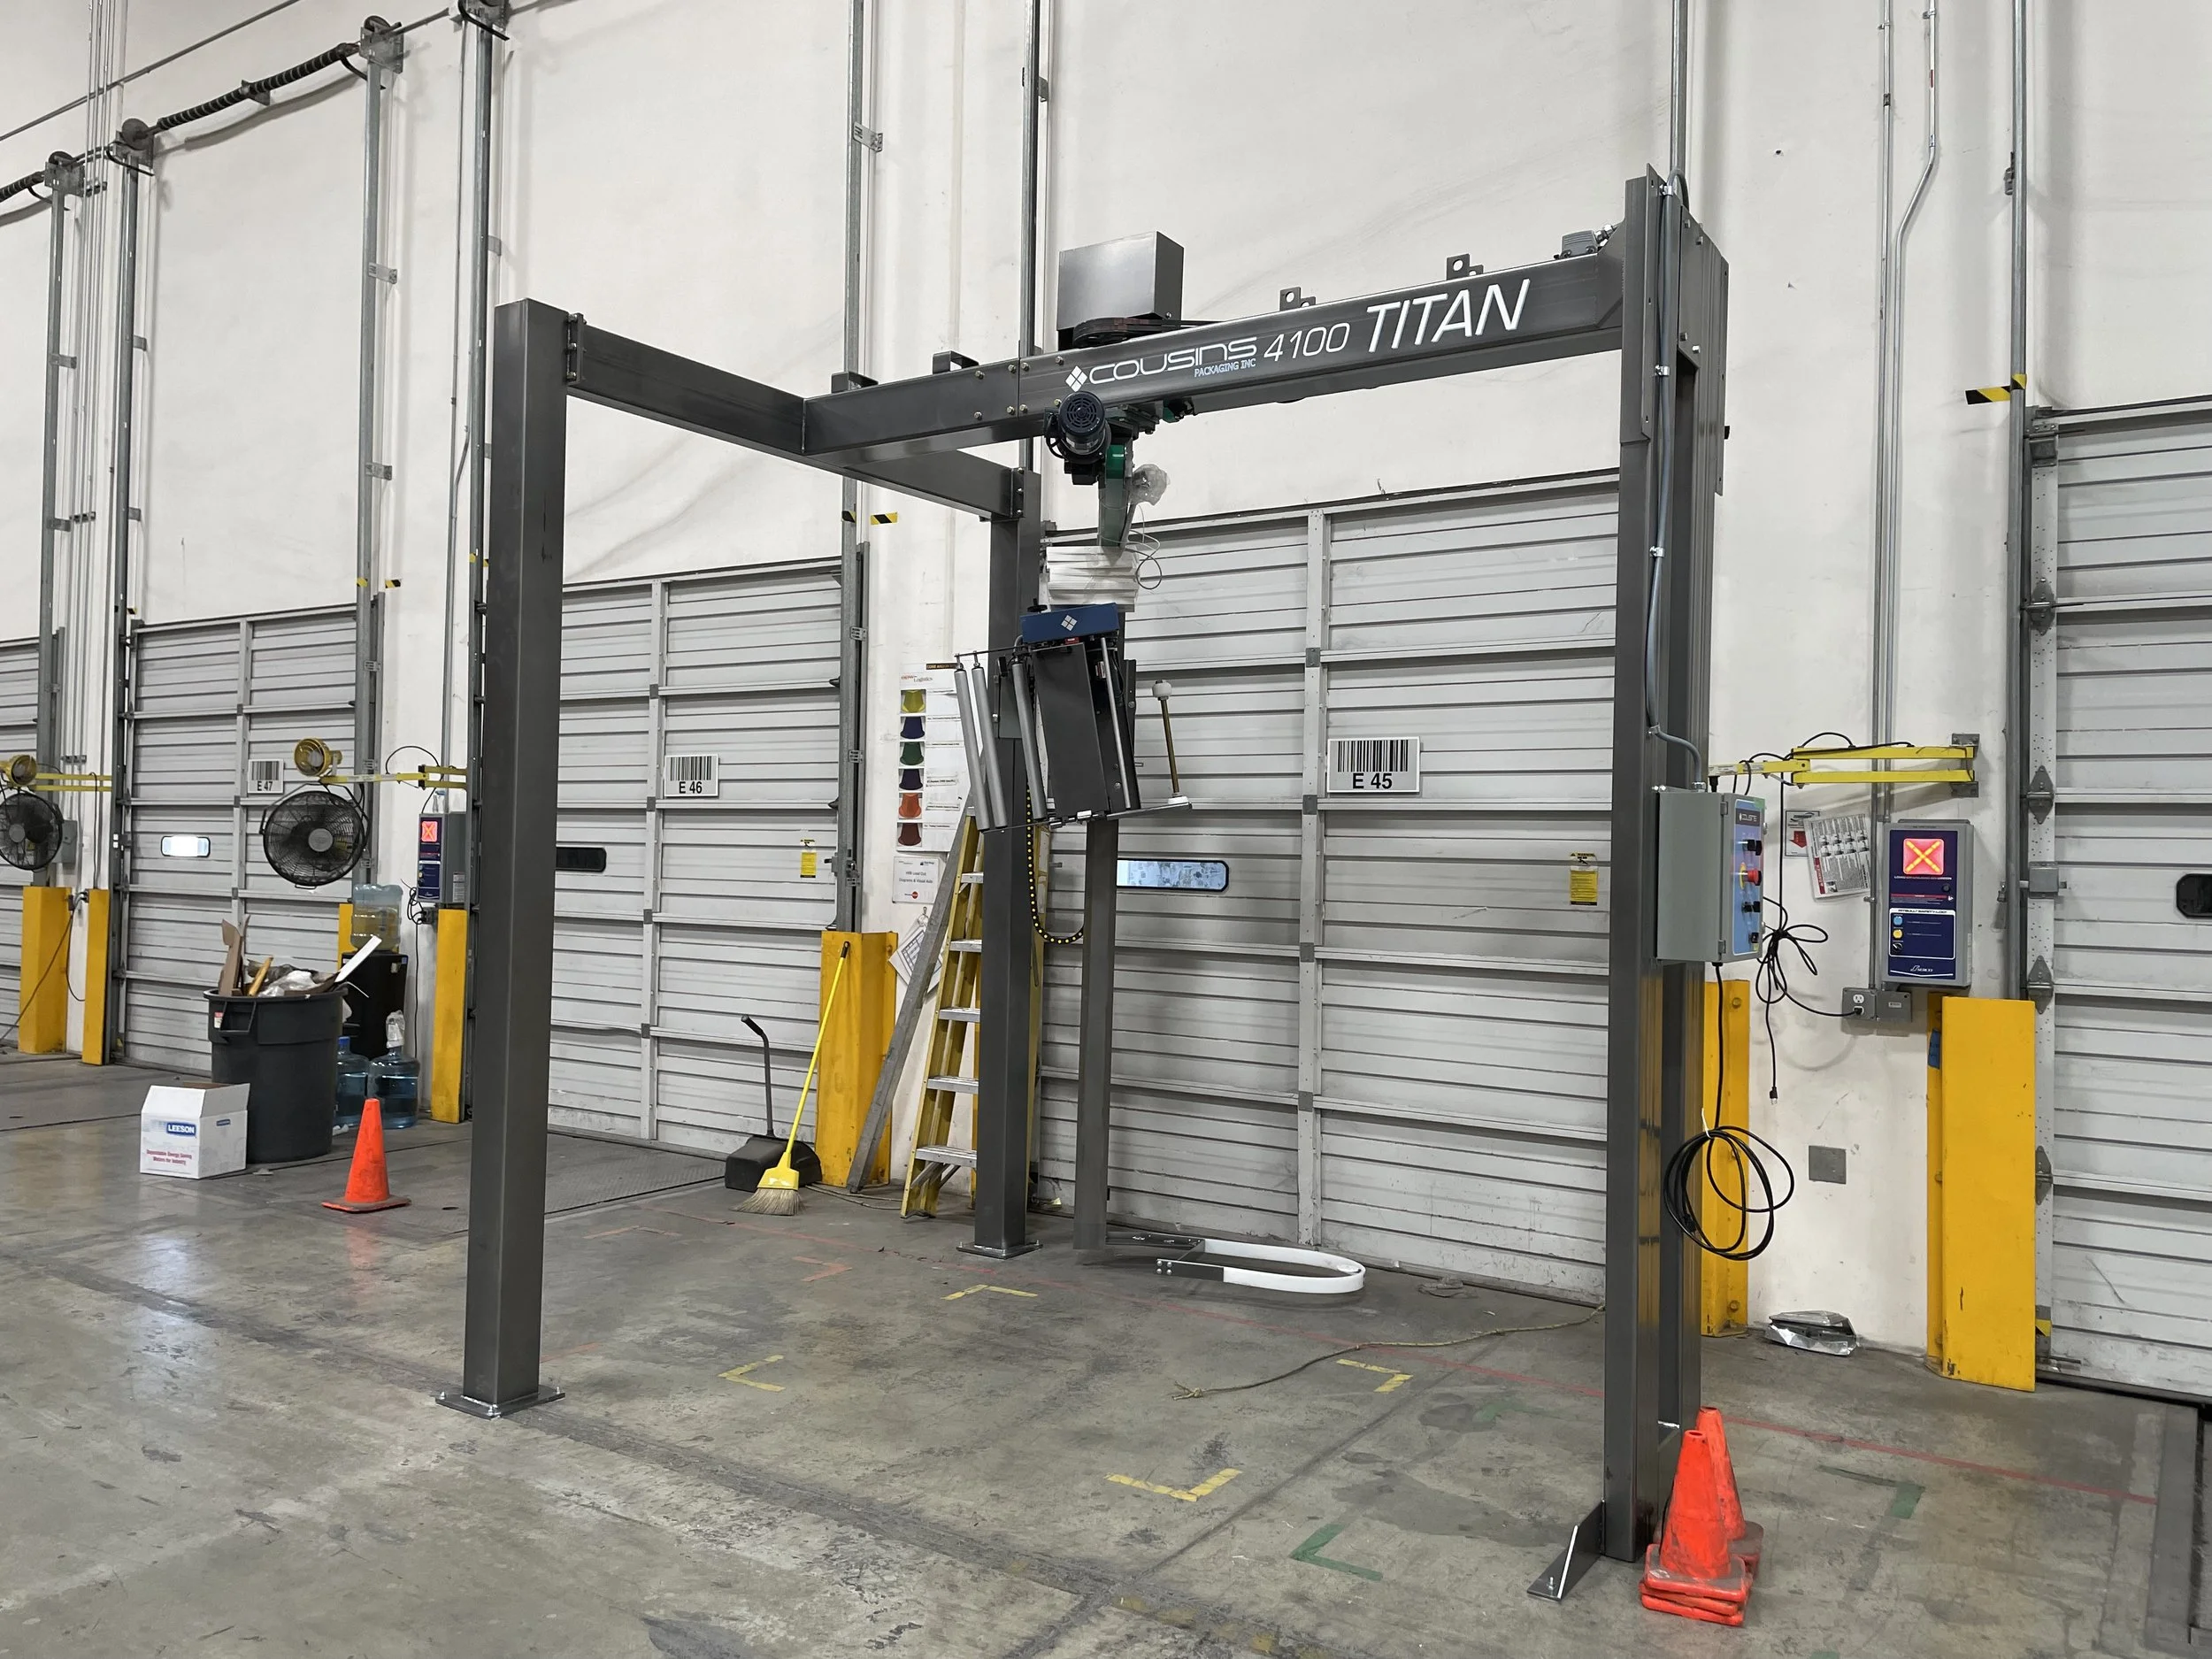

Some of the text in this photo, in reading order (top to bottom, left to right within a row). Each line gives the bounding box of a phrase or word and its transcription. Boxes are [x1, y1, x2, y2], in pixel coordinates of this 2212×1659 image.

[1089, 279, 1531, 385] COUSINS 4100 TITAN
[1194, 357, 1256, 378] PACKAGING INC
[257, 780, 273, 792] E 47
[679, 780, 703, 794] E 46
[1352, 772, 1393, 789] E 45
[167, 1125, 195, 1133] LEESON
